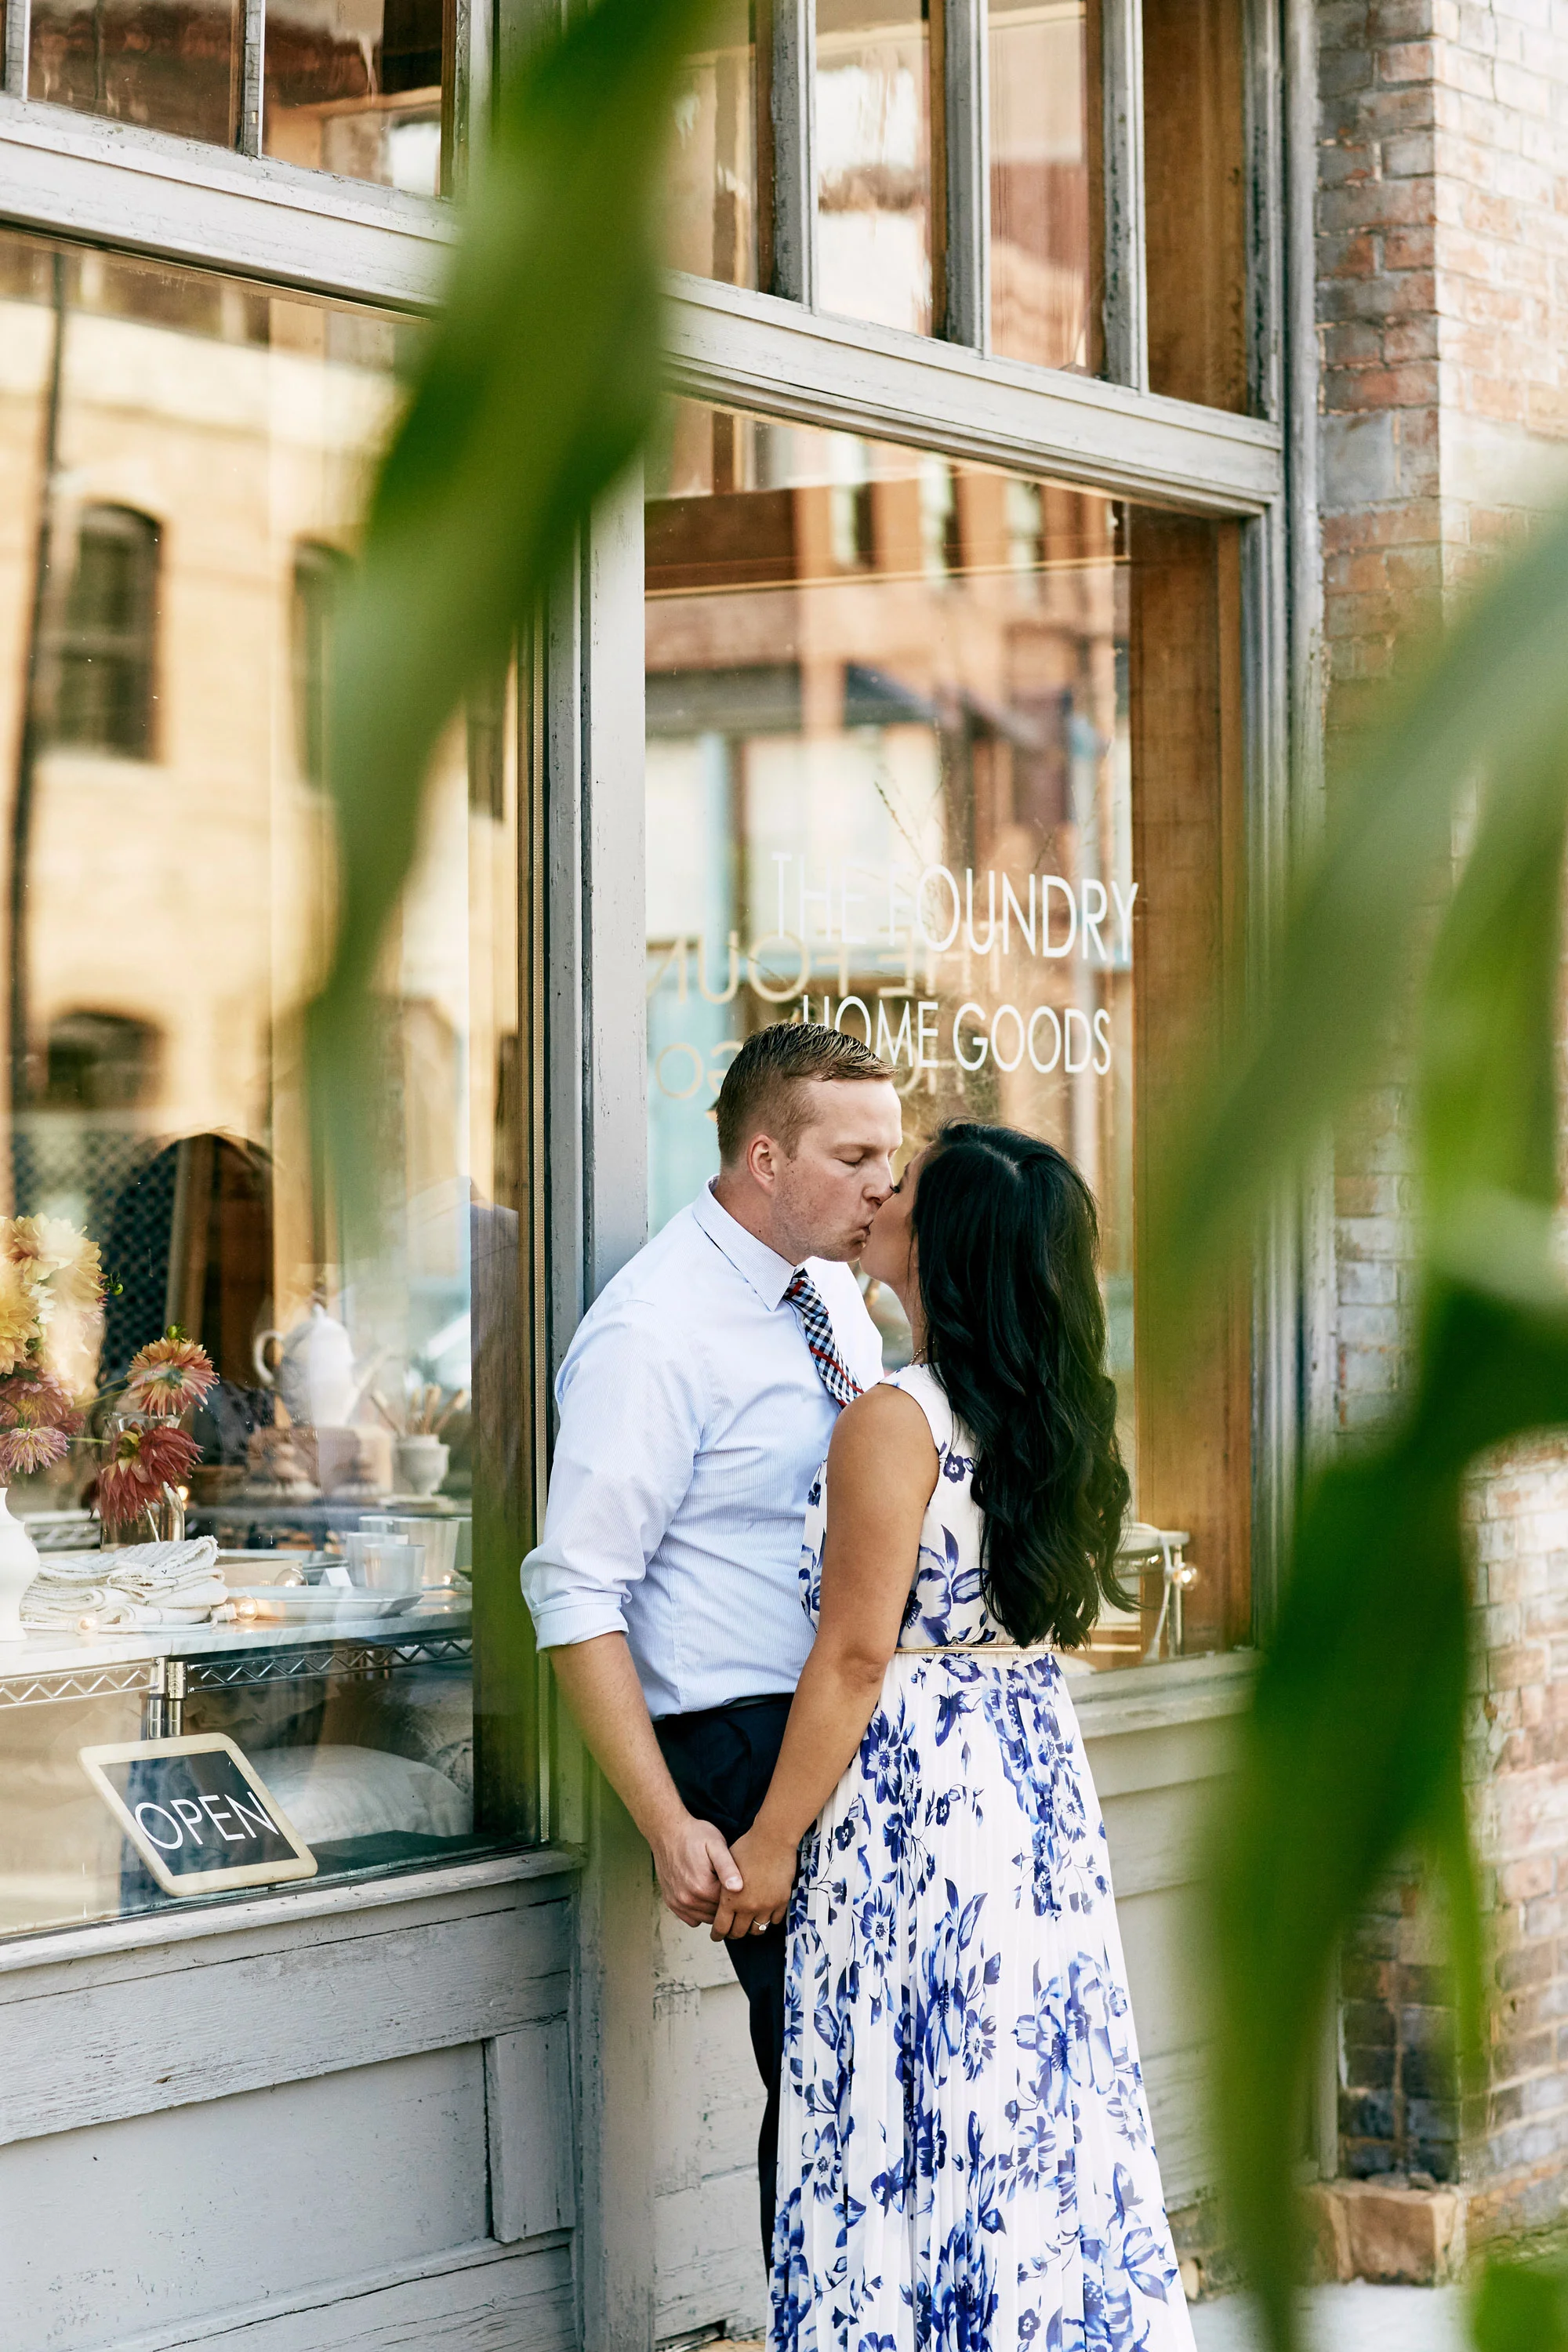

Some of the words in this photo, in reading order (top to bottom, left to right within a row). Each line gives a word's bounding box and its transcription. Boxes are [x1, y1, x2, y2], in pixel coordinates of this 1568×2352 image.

[771, 851, 866, 945] THE
[888, 862, 1139, 962] FOUNDRY
[953, 1002, 1112, 1076] GOODS
[134, 1791, 280, 1850] OPEN
